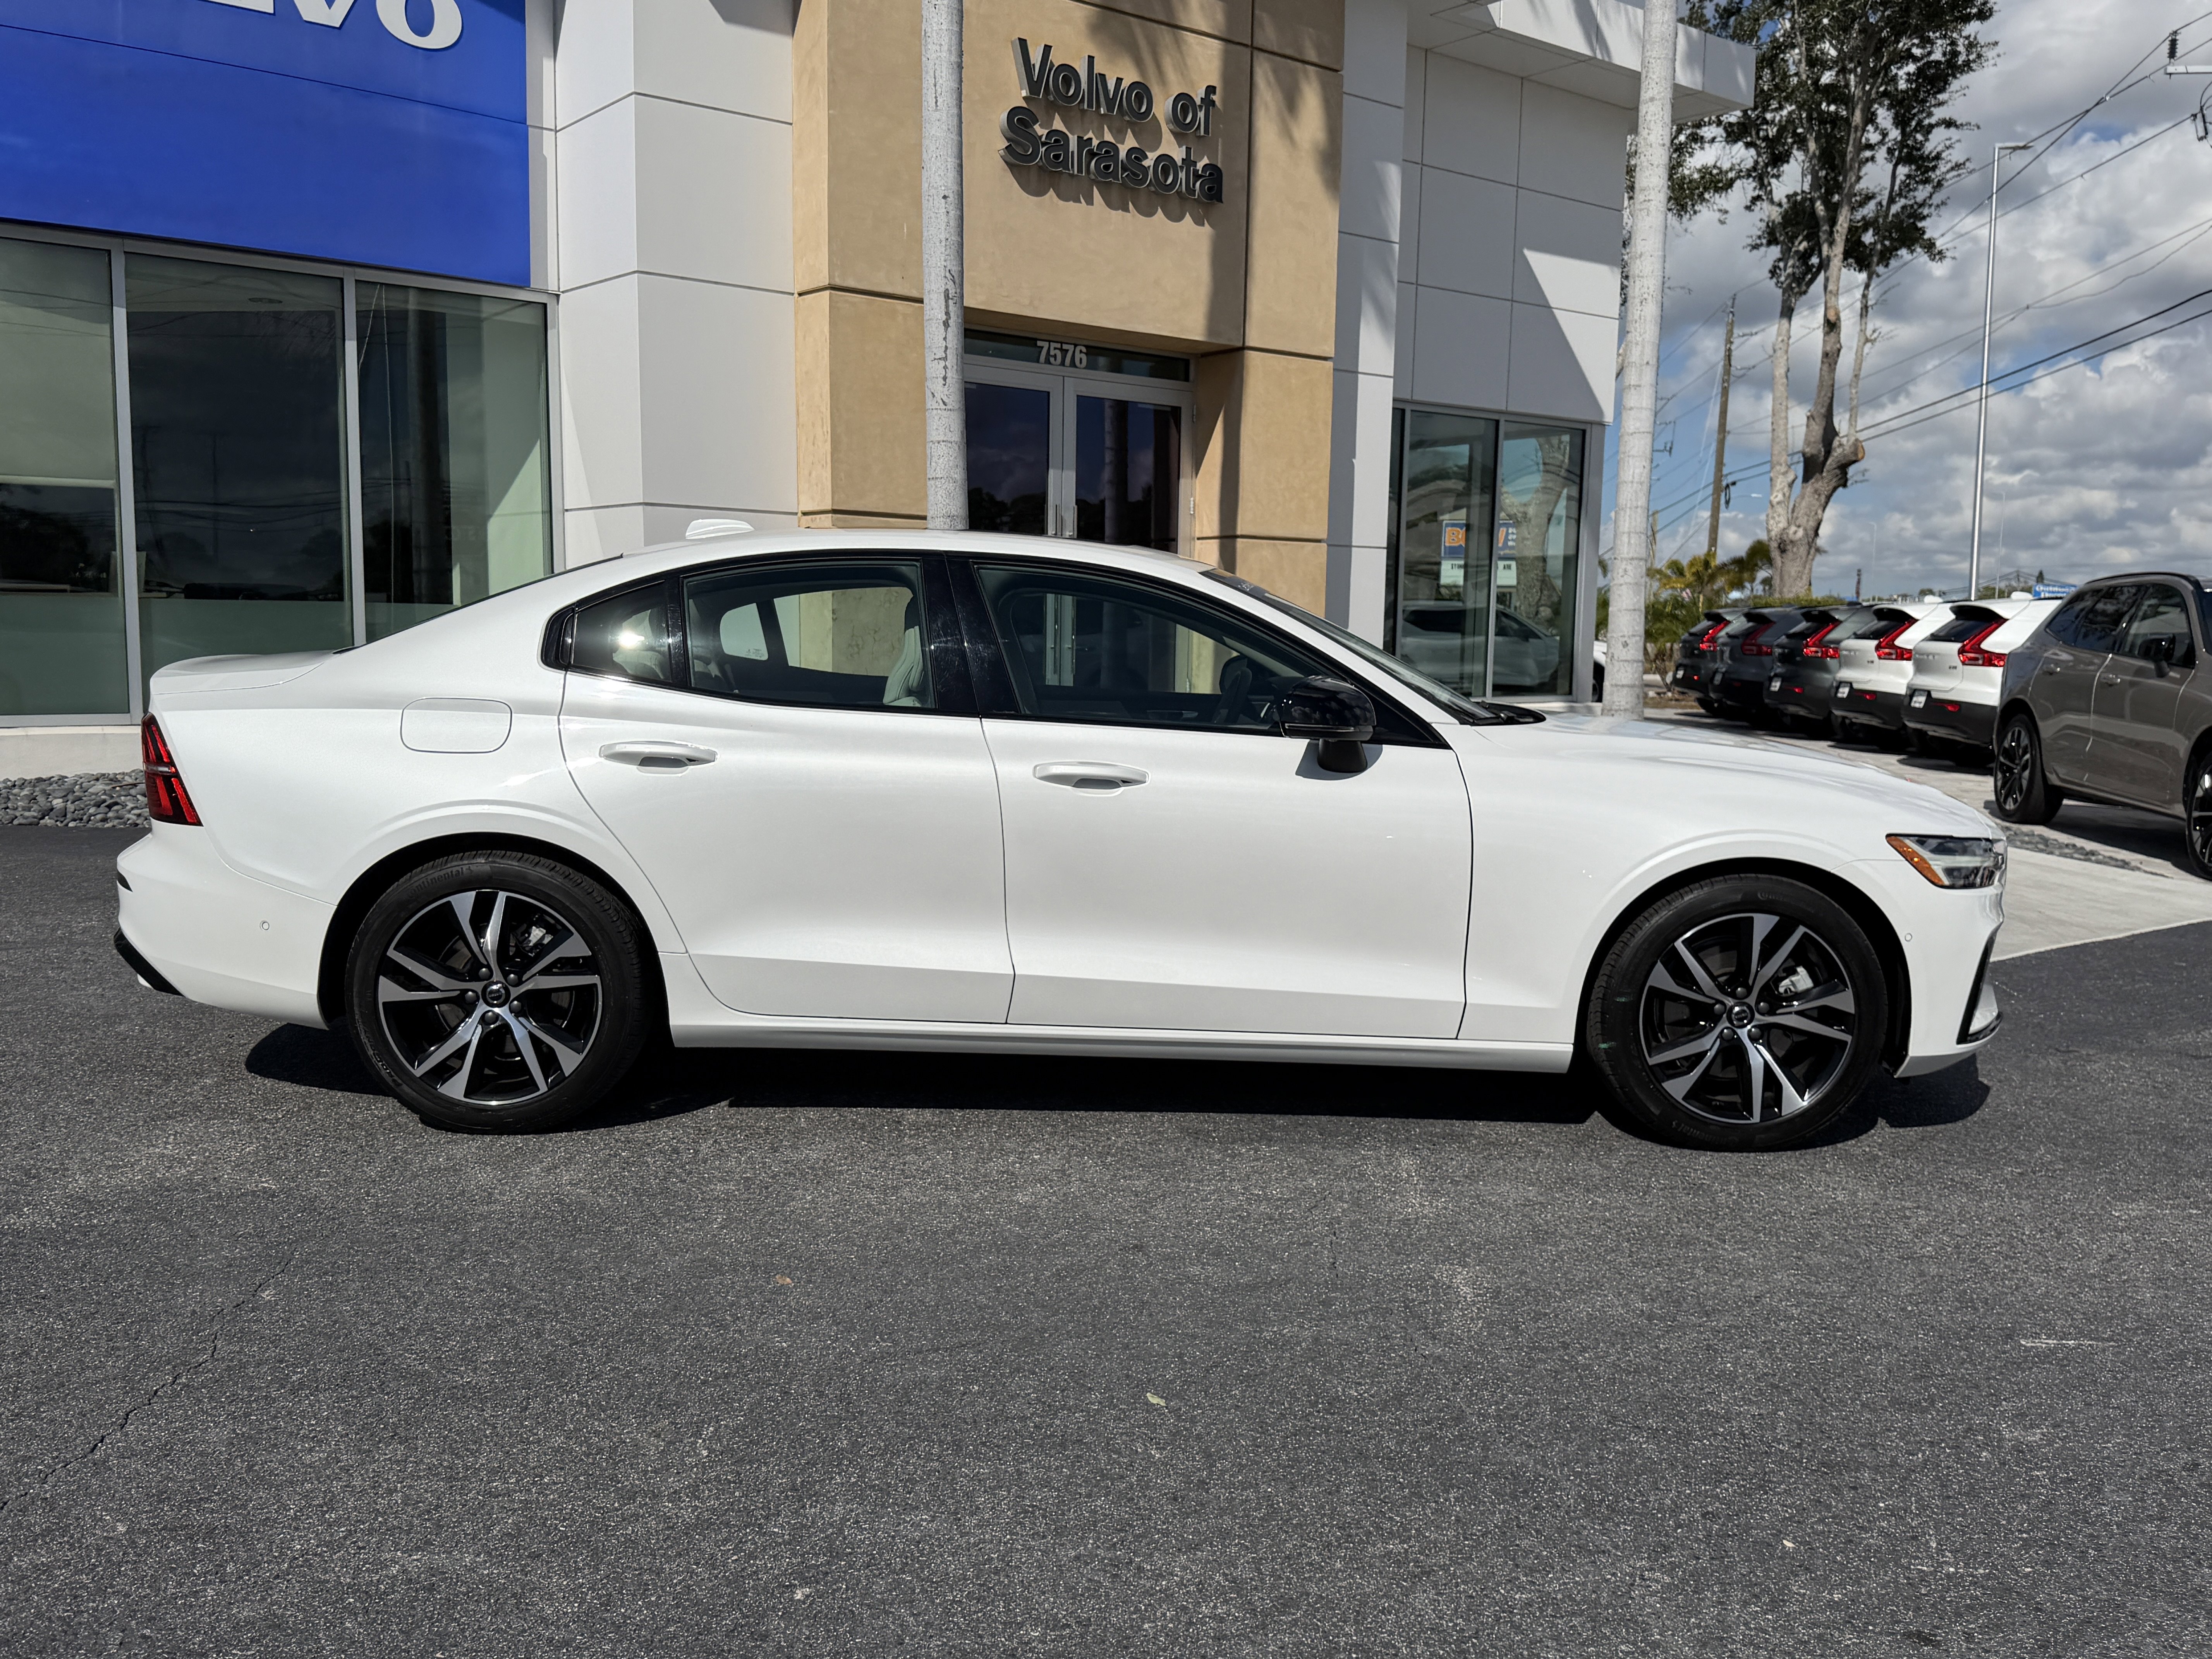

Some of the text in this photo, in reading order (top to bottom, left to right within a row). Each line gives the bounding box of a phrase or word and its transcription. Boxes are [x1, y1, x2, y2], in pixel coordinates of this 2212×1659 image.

[1012, 37, 1217, 136] Volvo of
[998, 106, 1223, 204] Sarasota
[1037, 340, 1087, 369] 7576
